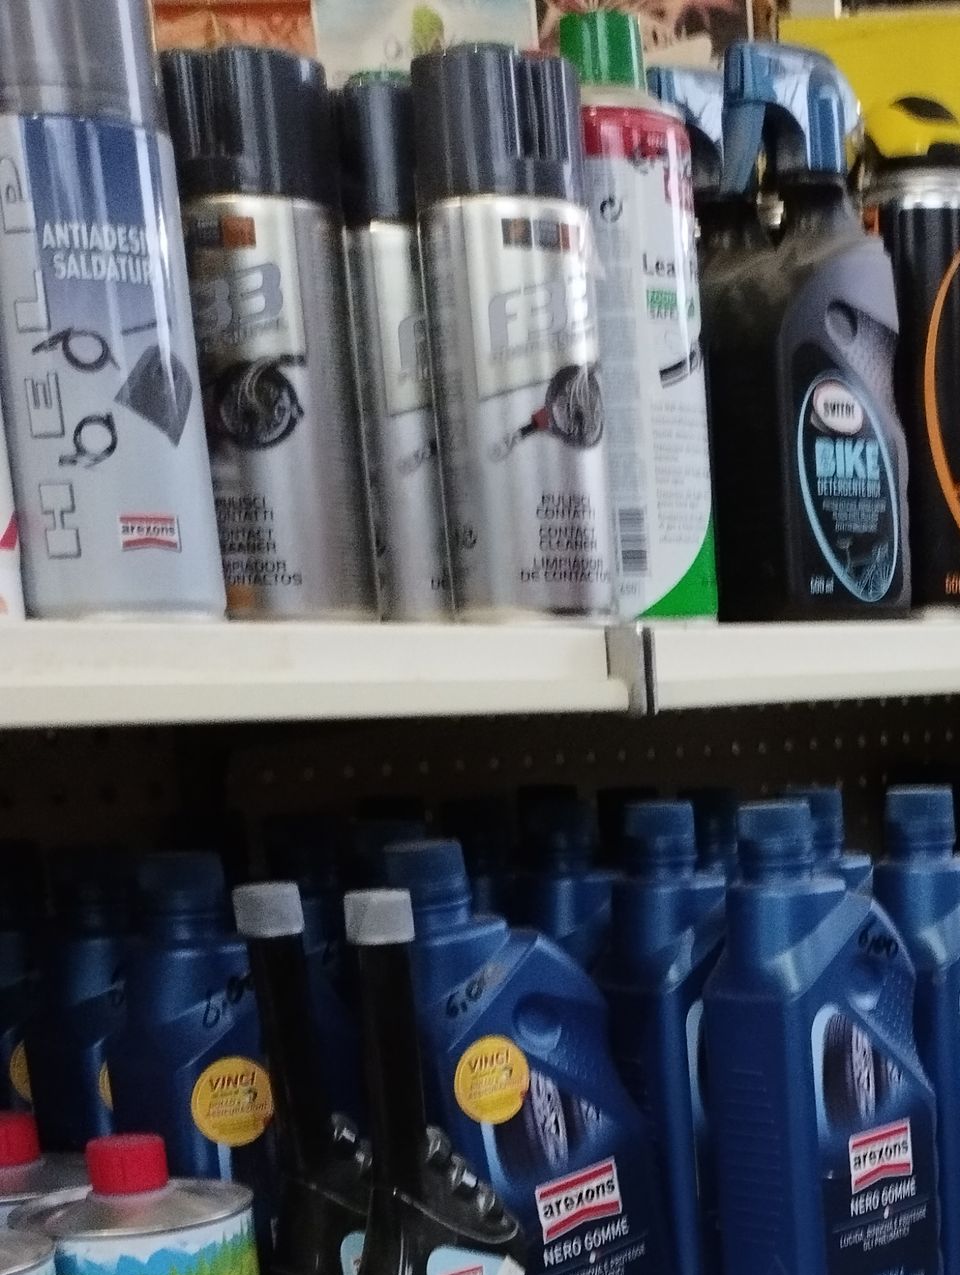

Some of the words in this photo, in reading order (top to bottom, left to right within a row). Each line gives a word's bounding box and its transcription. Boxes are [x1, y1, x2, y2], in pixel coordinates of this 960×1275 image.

[43, 221, 151, 257] ANTIADESI
[52, 252, 152, 286] SALDATUR
[815, 436, 880, 479] BIKE
[120, 523, 177, 537] arexons
[469, 1049, 511, 1073] VINCI
[209, 1072, 256, 1090] VINCI
[853, 1139, 909, 1171] arexons
[542, 1176, 615, 1219] arexons
[850, 1190, 879, 1218] NERO
[881, 1175, 916, 1205] GOMME
[543, 1237, 582, 1268] NERO
[584, 1214, 630, 1251] GOMME
